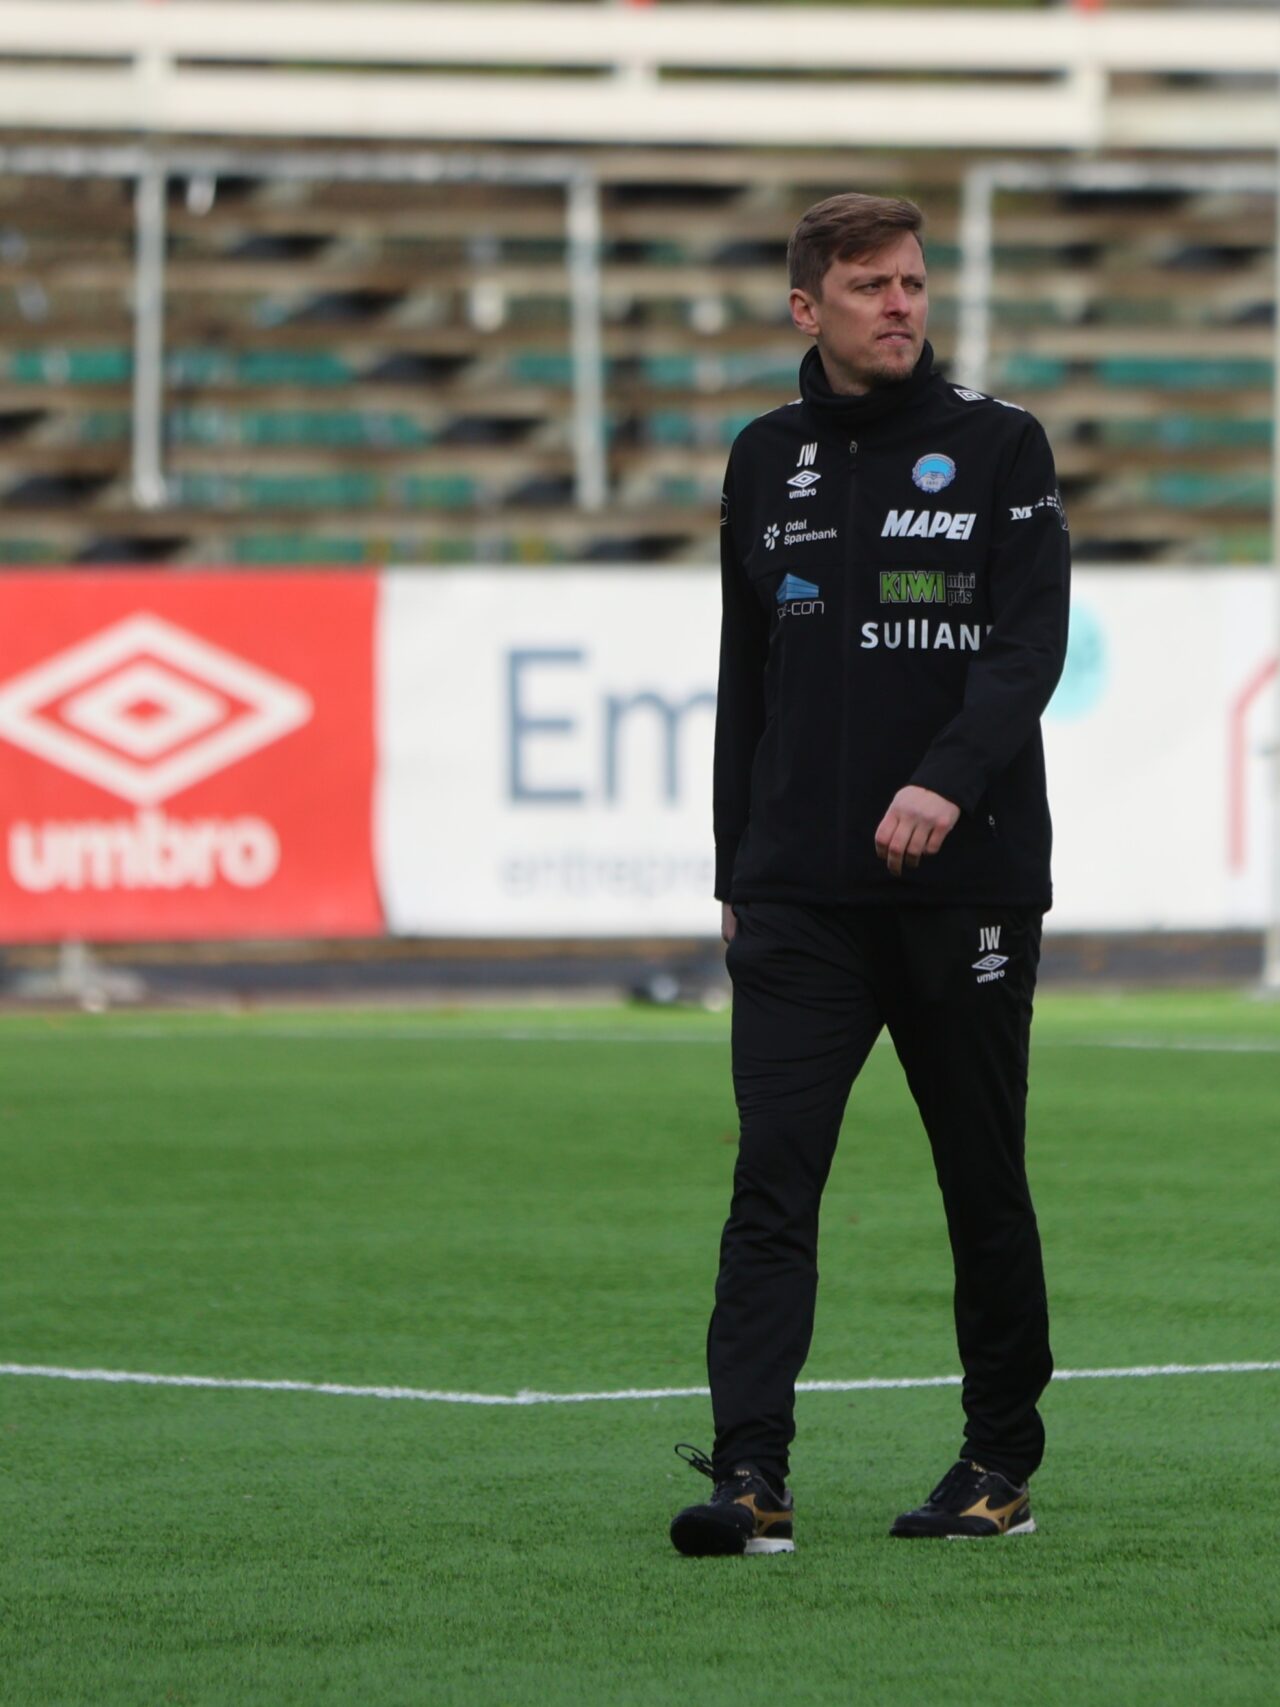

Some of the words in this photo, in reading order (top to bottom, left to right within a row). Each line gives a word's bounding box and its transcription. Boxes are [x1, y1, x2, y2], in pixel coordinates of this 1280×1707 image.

[796, 441, 818, 468] JW
[788, 487, 817, 499] umbro
[785, 519, 808, 533] Odal
[880, 509, 977, 541] MAPEI
[783, 528, 838, 546] Sparebank
[879, 570, 946, 604] KIWI
[946, 572, 976, 589] mini
[947, 588, 973, 607] pris
[7, 803, 281, 892] umbro
[978, 925, 1001, 952] JW
[976, 969, 1005, 984] umbro
